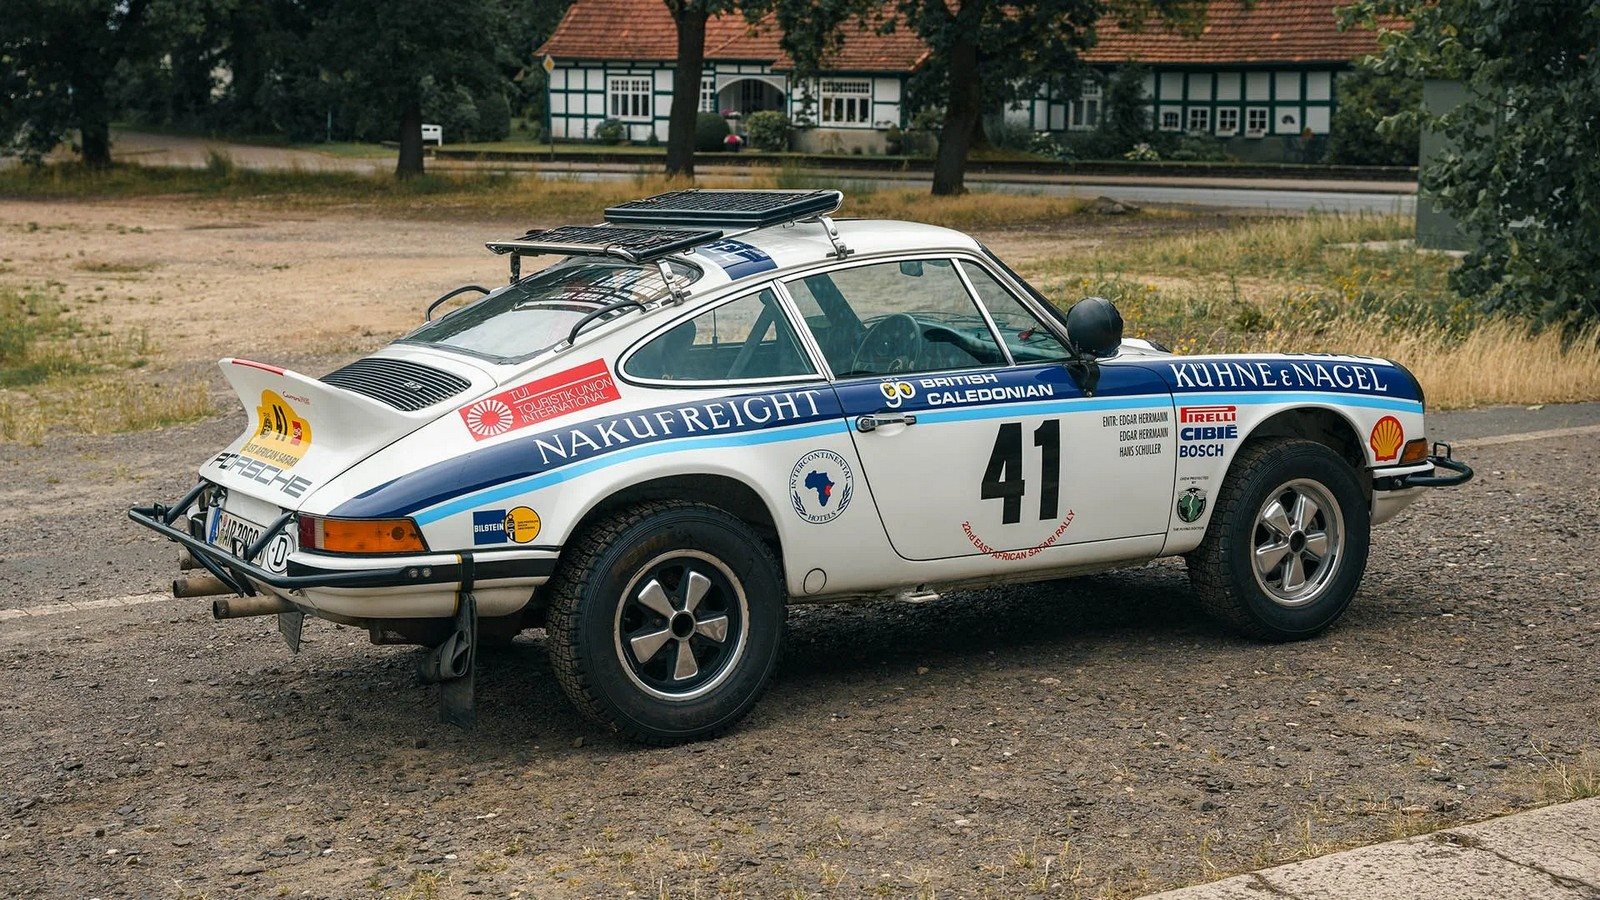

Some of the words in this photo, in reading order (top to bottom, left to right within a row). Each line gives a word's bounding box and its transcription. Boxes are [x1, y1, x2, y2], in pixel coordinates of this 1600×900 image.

[919, 374, 998, 389] BRITISH
[1169, 362, 1278, 388] KÜHNE
[1291, 363, 1387, 392] NAGEL
[509, 387, 530, 401] TUI
[516, 387, 576, 415] TOURISTIK
[575, 376, 613, 397] UNION
[926, 384, 1054, 406] CALEDONIAN
[520, 391, 609, 423] INTERNATIONAL
[1180, 405, 1237, 423] PIRELLI
[532, 390, 820, 465] NAKUFREIGHT
[1119, 413, 1137, 426] EDGAR
[1138, 411, 1168, 424] HERRMANN
[1119, 429, 1137, 442] EDGAR
[1138, 427, 1168, 440] HERRMANN
[1119, 445, 1134, 457] HANS
[1180, 444, 1224, 458] BOSCH
[208, 452, 313, 498] PORSCHE
[791, 452, 851, 489] INTERCONTINENTAL
[981, 419, 1060, 525] 41
[474, 522, 504, 533] BILSTEIN
[808, 511, 836, 522] HOTELS
[962, 521, 975, 542] 22nd
[974, 534, 994, 555] EAST
[991, 550, 1027, 561] AFRICAN
[1028, 535, 1057, 557] SAFARI
[1056, 509, 1076, 538] RALLY
[273, 536, 288, 567] D
